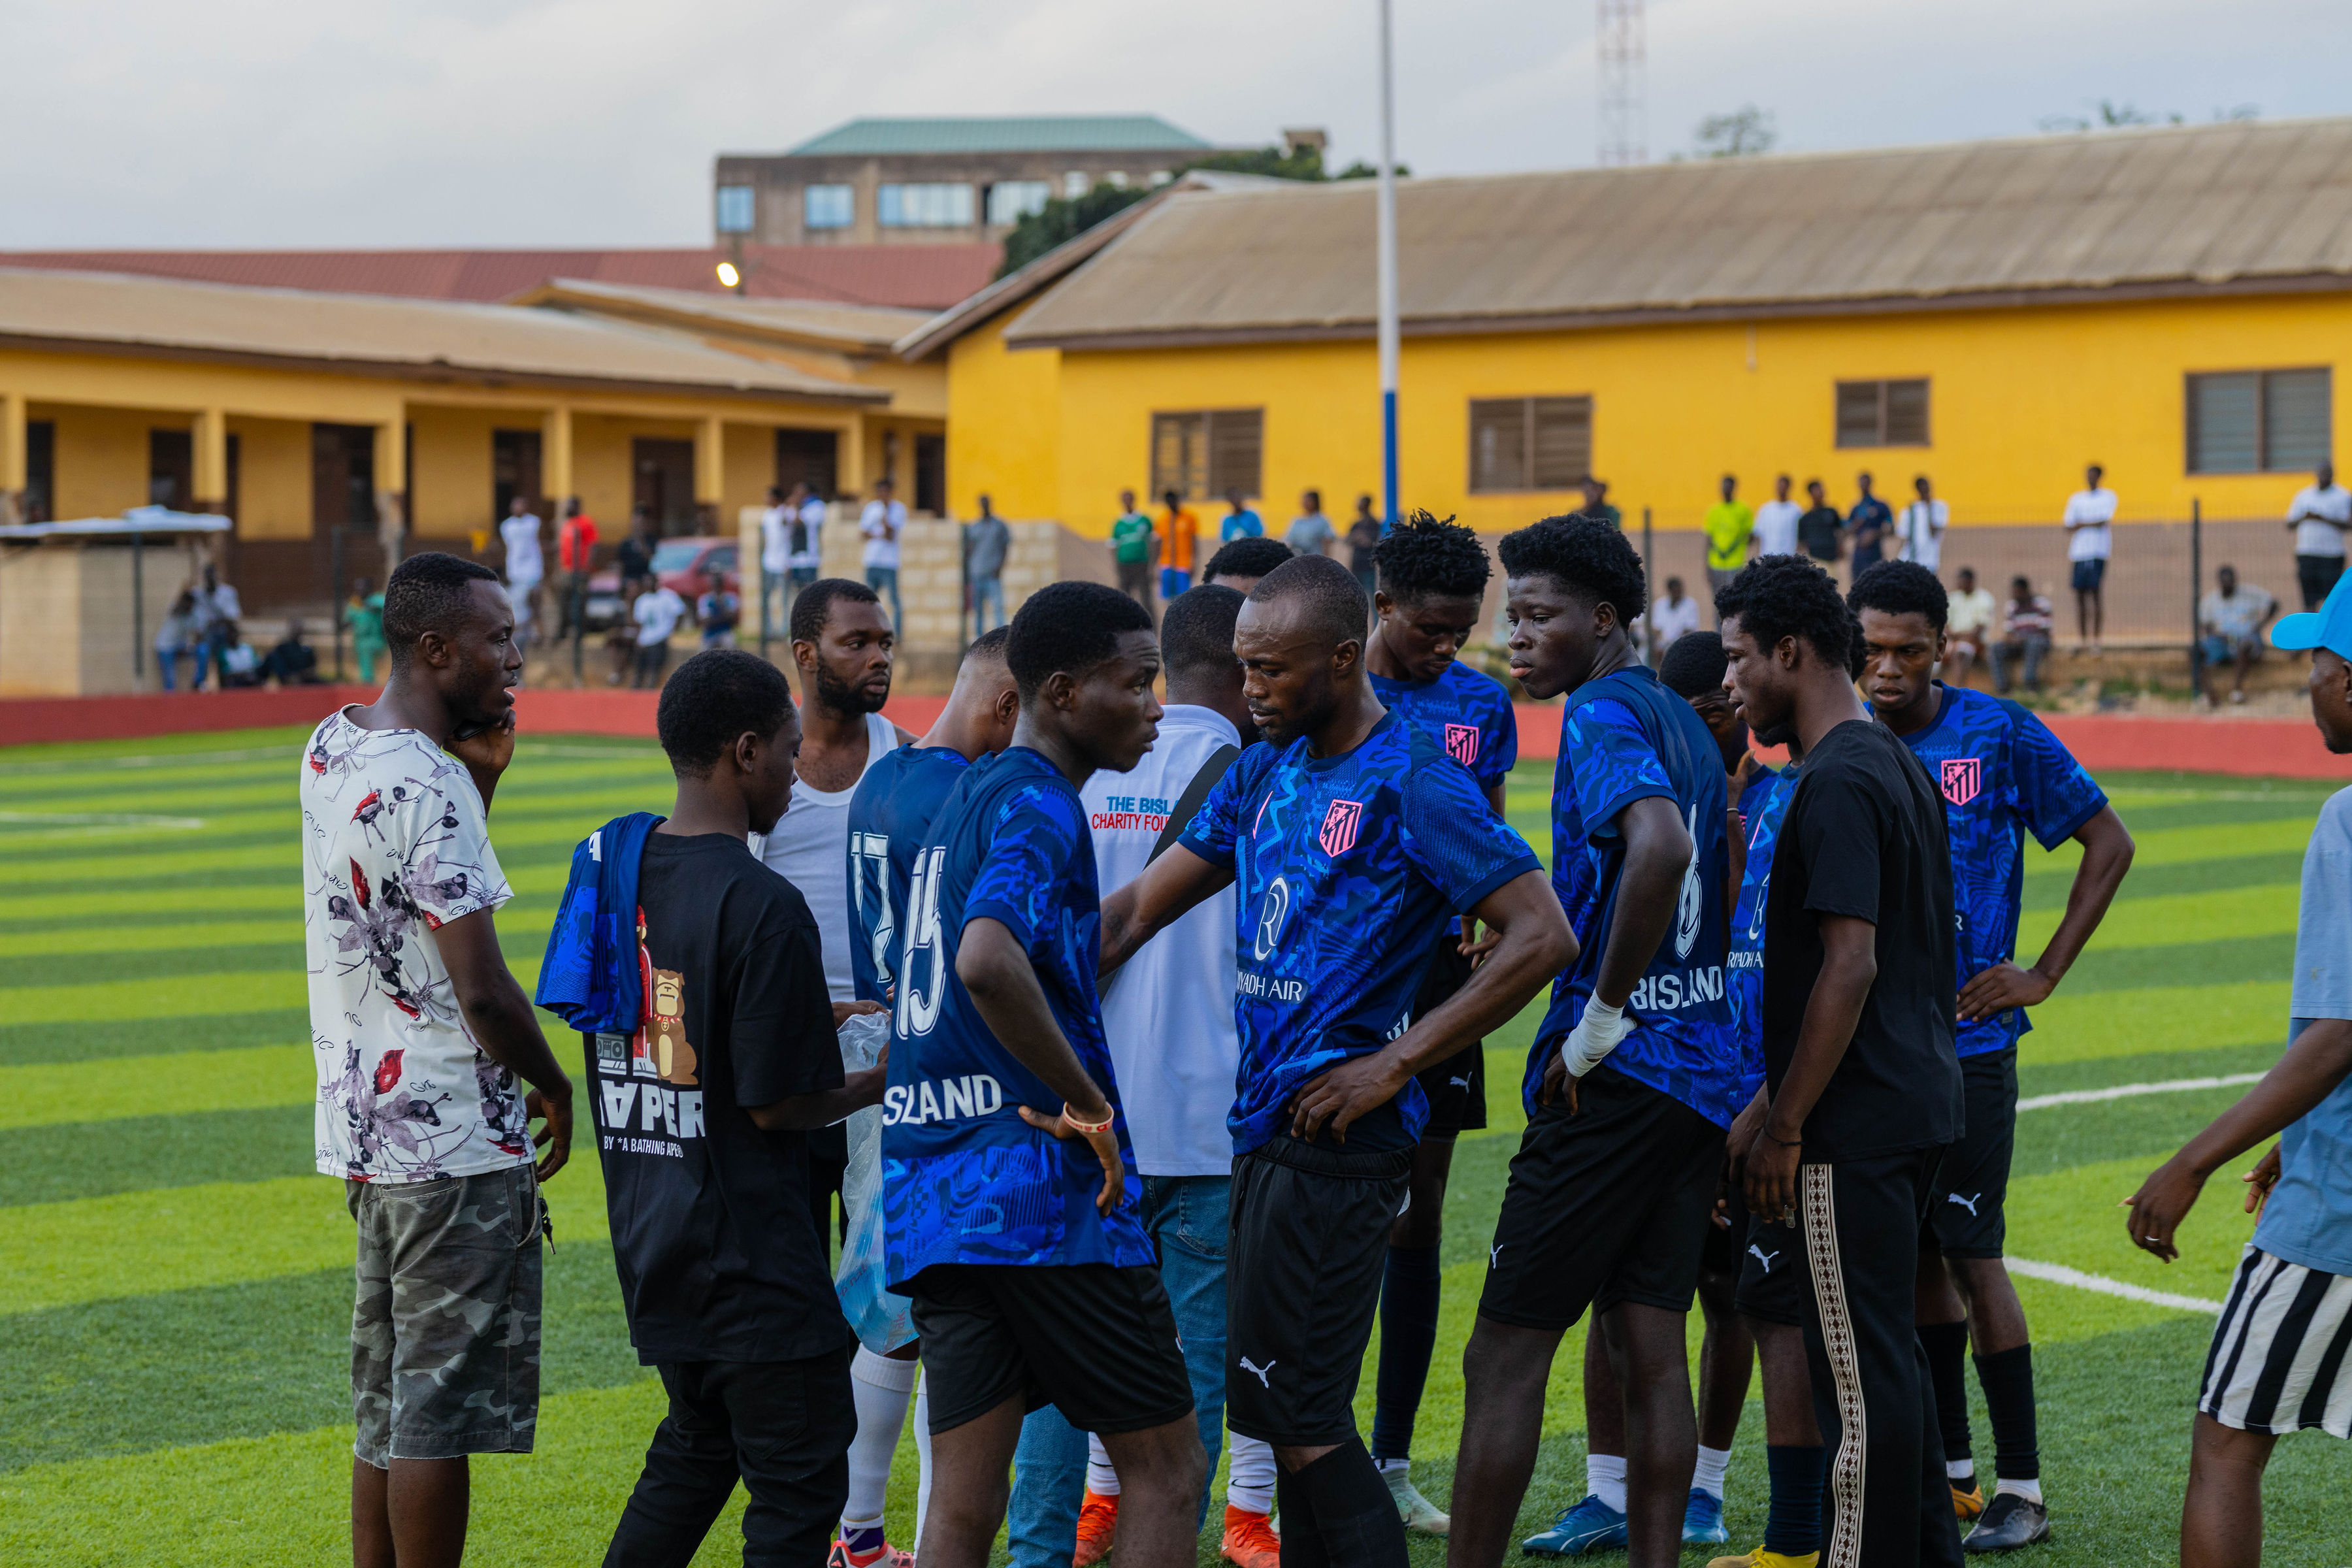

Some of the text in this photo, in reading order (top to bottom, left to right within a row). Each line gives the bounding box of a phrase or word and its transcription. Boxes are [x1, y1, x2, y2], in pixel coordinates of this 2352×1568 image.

[1106, 796, 1179, 815] THE BISL
[1092, 813, 1142, 830] CHARITY
[896, 846, 947, 1041] 15
[1267, 979, 1303, 1001] AIR
[604, 1135, 614, 1150] BY
[630, 1138, 665, 1156] BATHING
